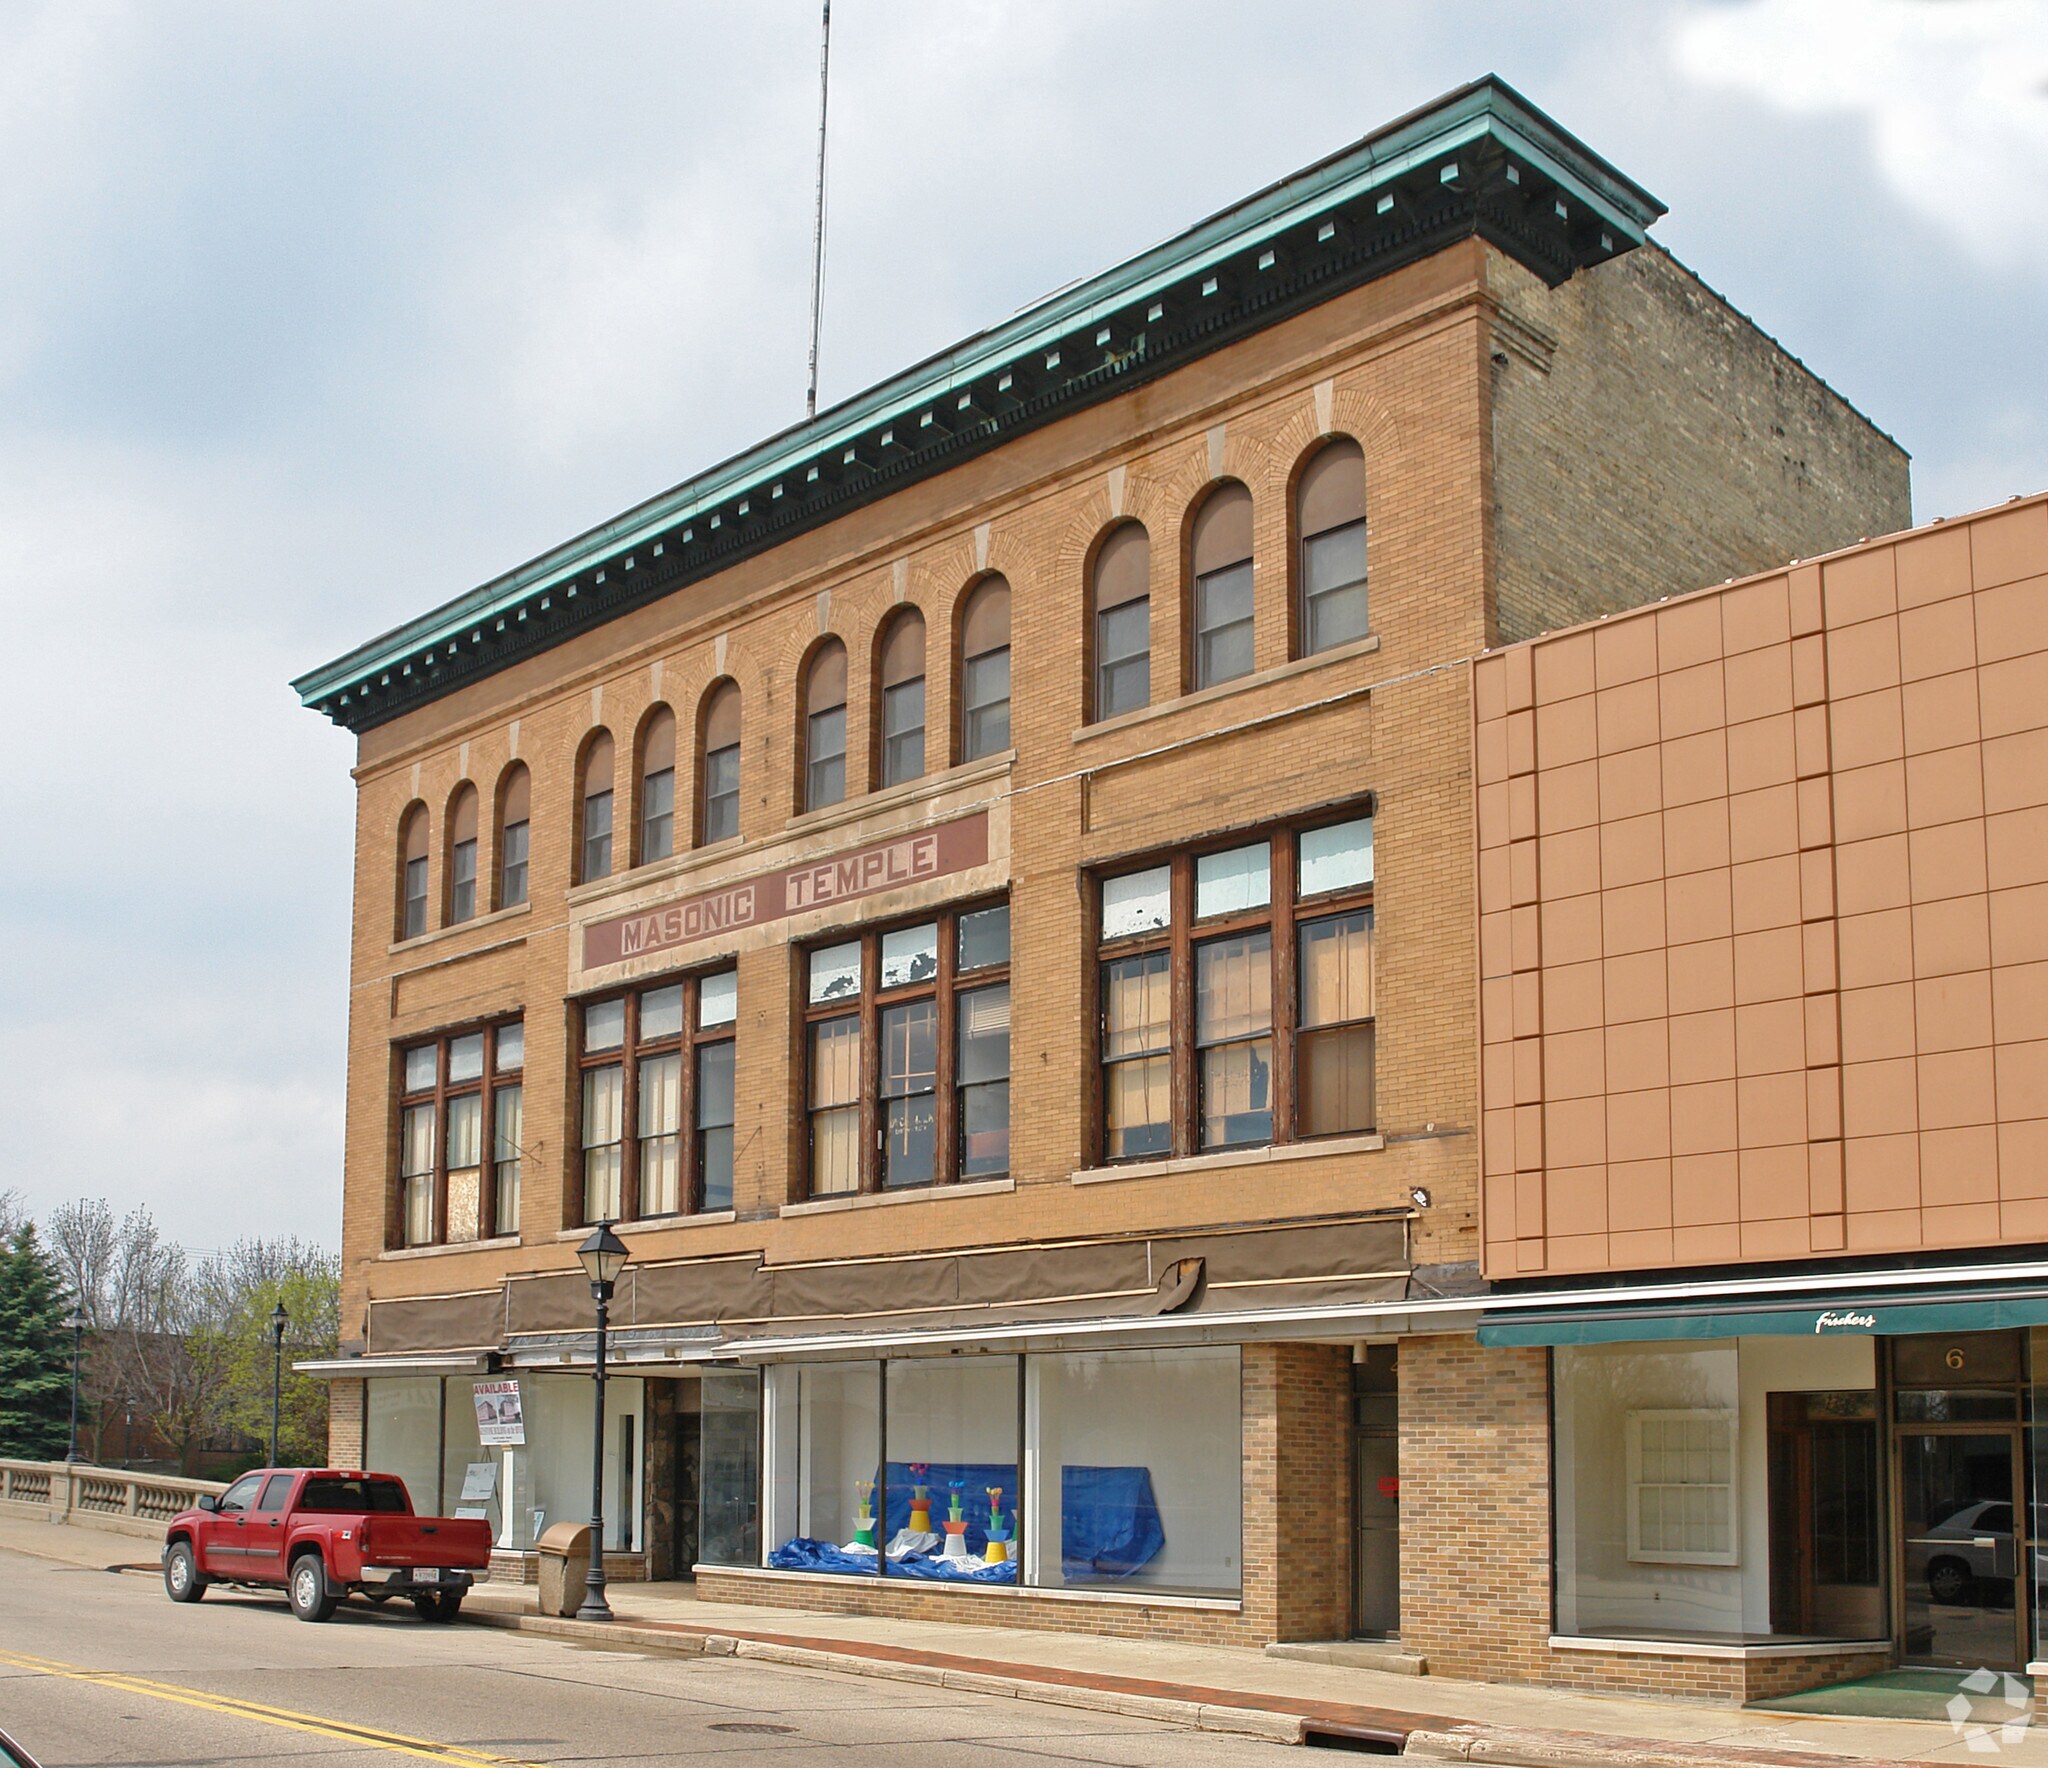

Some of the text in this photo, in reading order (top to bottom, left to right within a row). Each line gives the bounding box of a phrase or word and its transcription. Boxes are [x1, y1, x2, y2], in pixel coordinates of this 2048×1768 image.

[622, 834, 937, 955] MASONIC TEMPLE
[1945, 1348, 1966, 1369] 6
[474, 1382, 518, 1395] AVAILABLE
